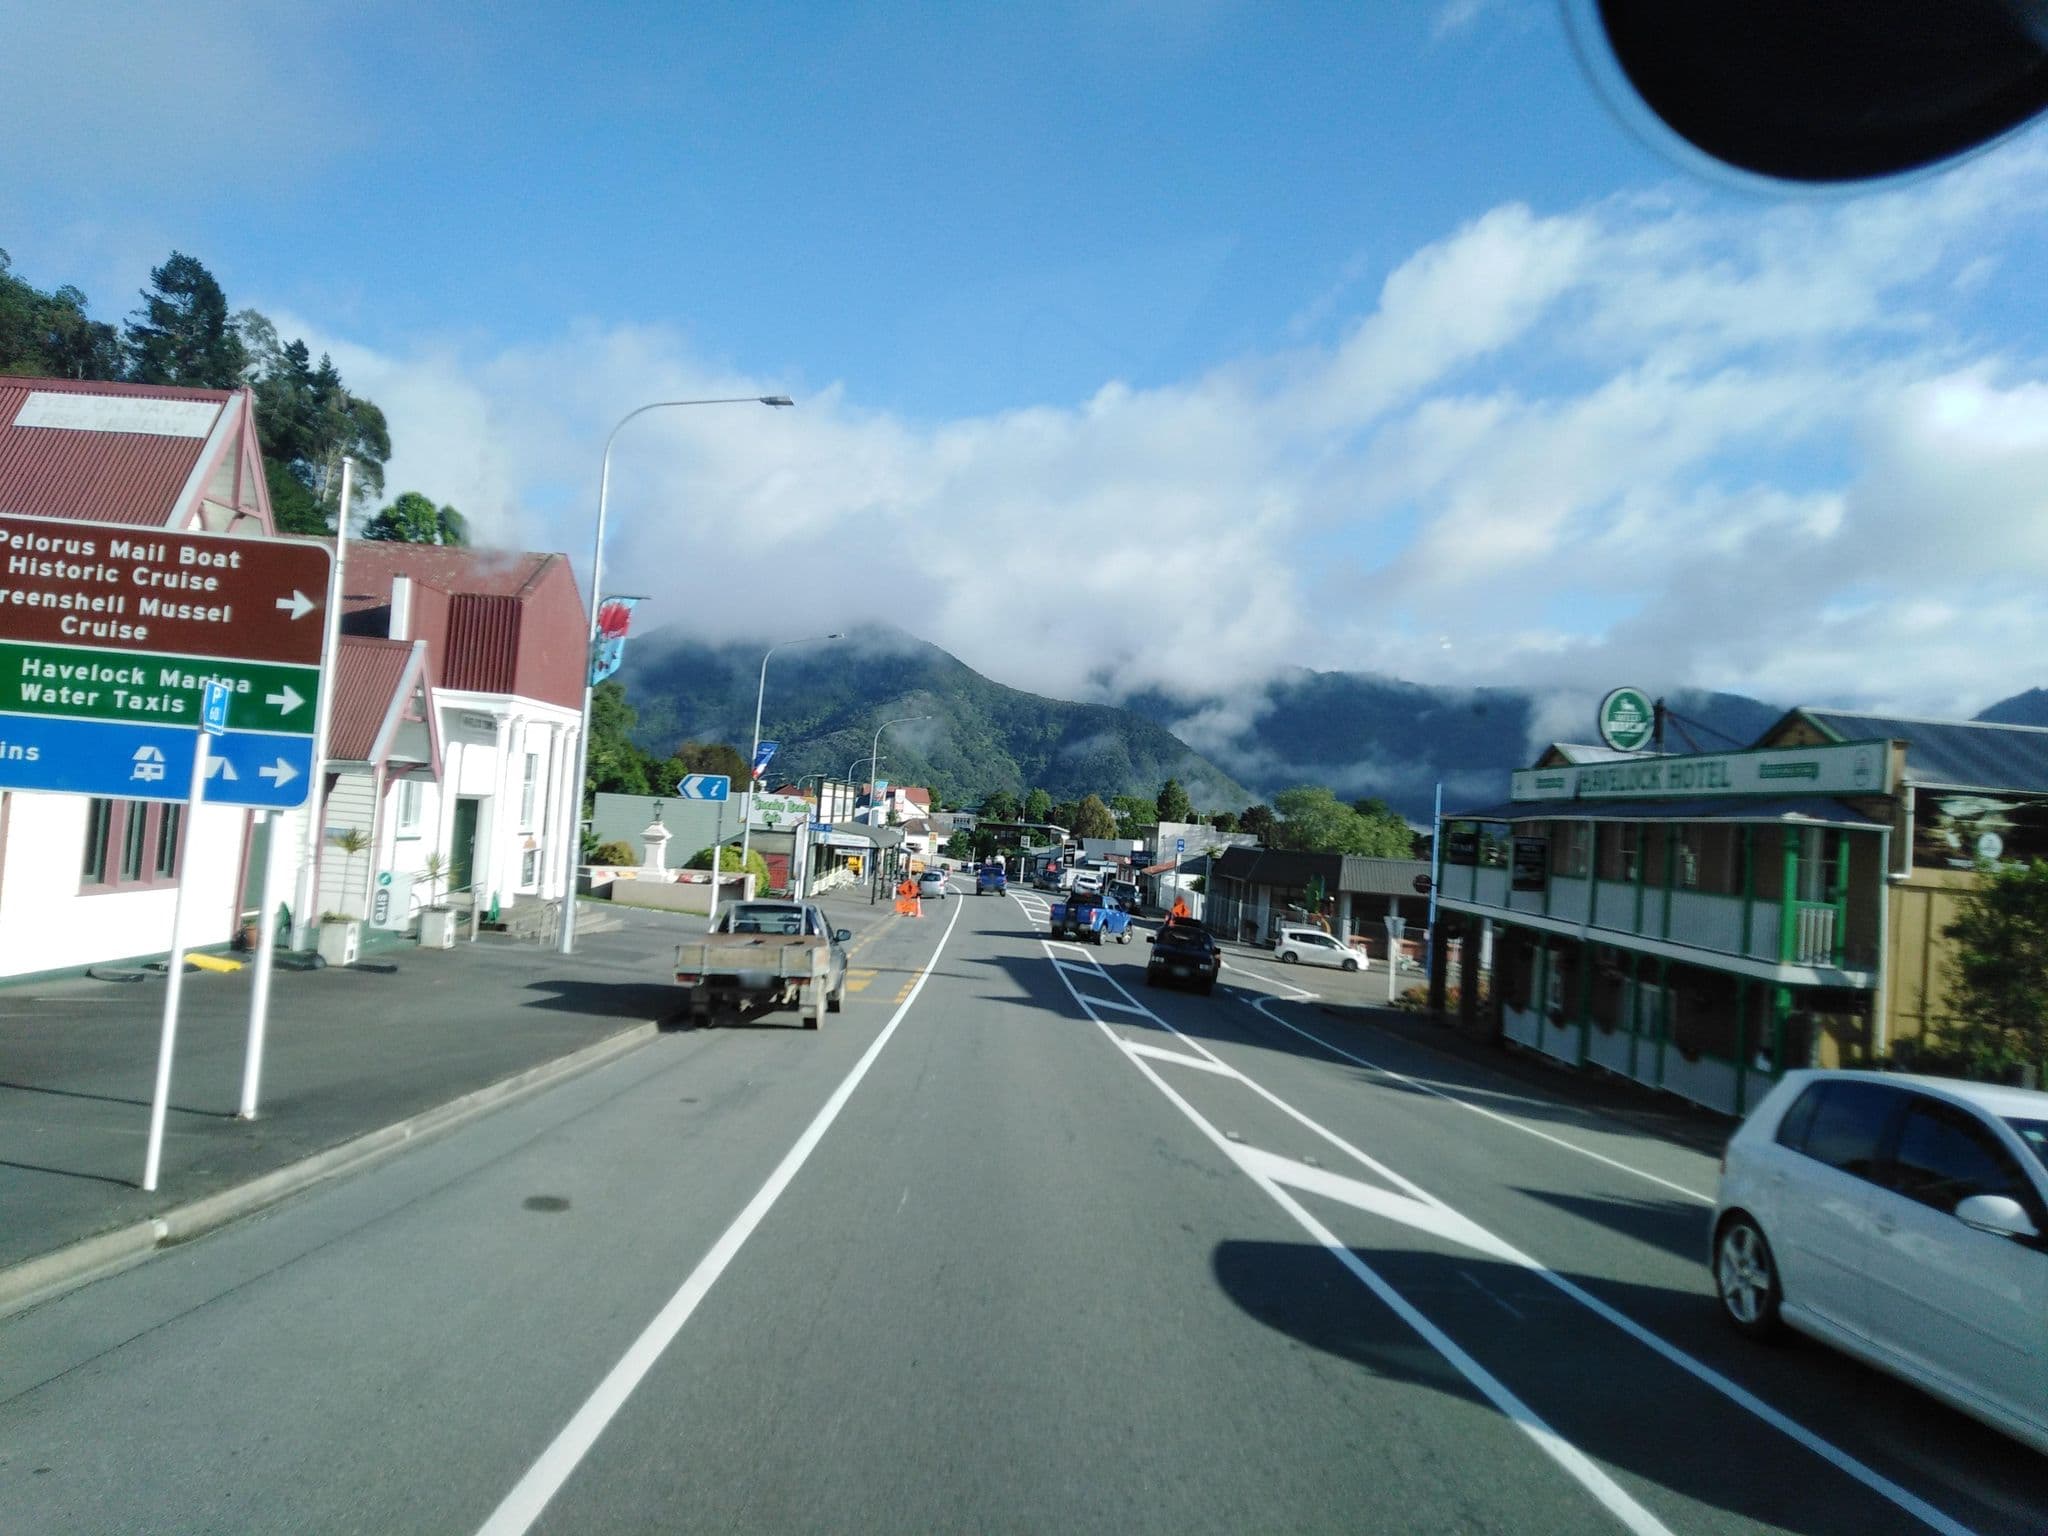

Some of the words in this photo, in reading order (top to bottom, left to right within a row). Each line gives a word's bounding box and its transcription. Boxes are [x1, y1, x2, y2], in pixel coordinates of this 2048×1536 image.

[0, 530, 96, 556] Pelorus
[109, 540, 166, 562] Mail
[179, 546, 241, 568] Boat
[8, 555, 120, 582] Historic
[132, 567, 219, 591] Cruise
[138, 597, 232, 623] Mussel
[60, 615, 148, 640] Cruise
[21, 658, 145, 685] Havelock
[21, 683, 99, 706] Water
[113, 690, 185, 713] Taxis
[1669, 761, 1732, 789] HOTEL
